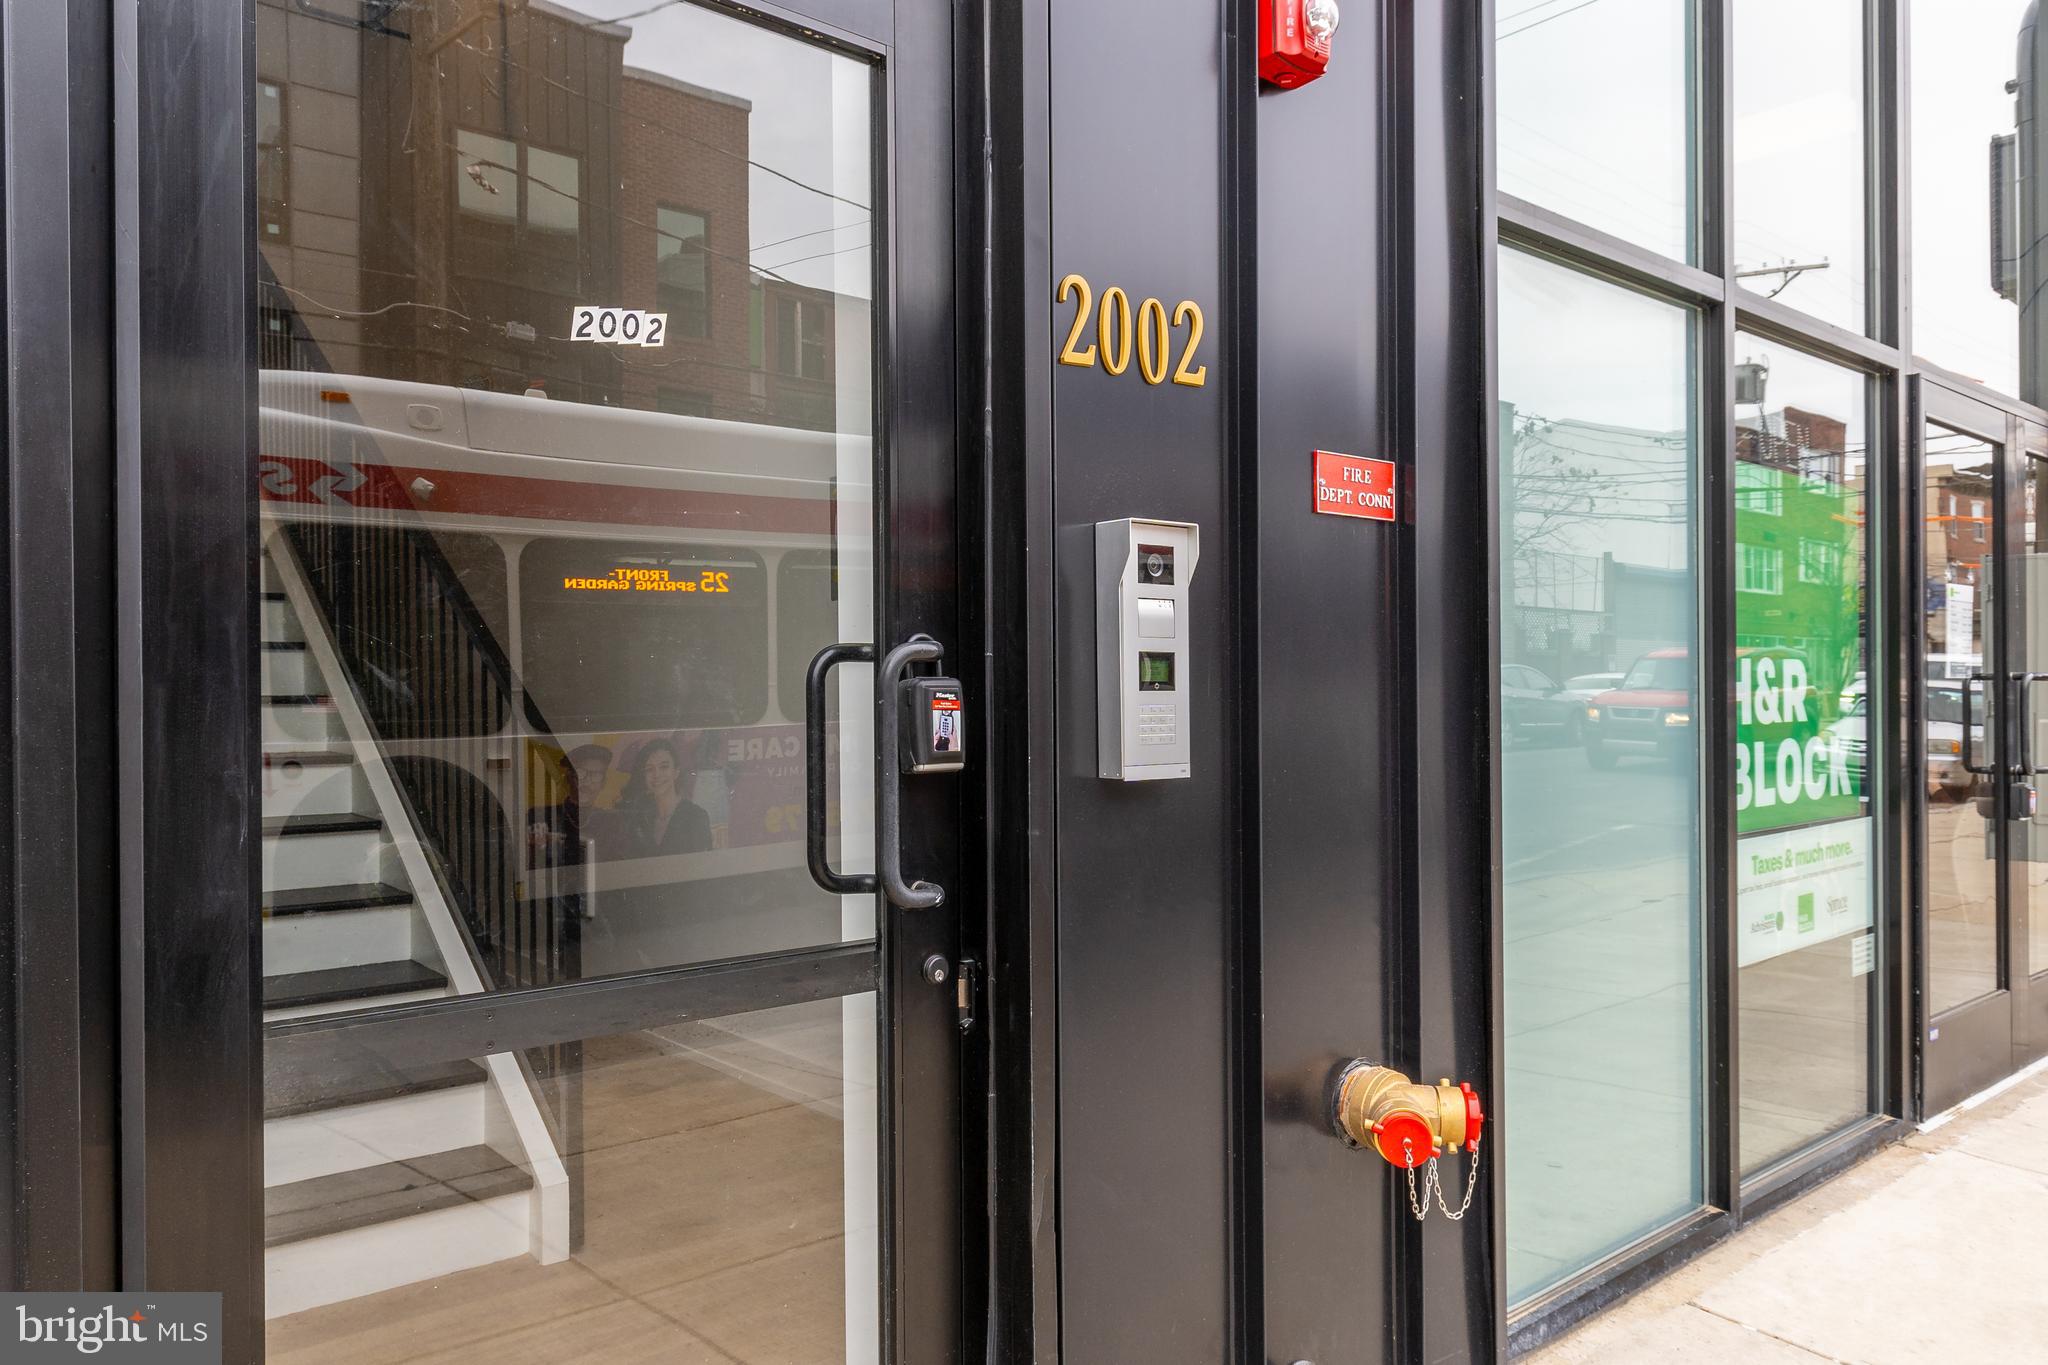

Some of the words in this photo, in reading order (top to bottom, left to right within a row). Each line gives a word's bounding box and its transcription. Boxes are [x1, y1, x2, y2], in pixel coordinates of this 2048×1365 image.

[575, 311, 662, 344] 2002
[1058, 274, 1206, 388] 2002
[1343, 466, 1372, 484] FIRE
[1320, 486, 1353, 504] DEPT.
[1358, 492, 1393, 509] CONN.
[1737, 734, 1853, 811] BLOCK
[1751, 853, 1783, 876] Taxes
[1784, 848, 1793, 868] &
[1795, 841, 1824, 866] much
